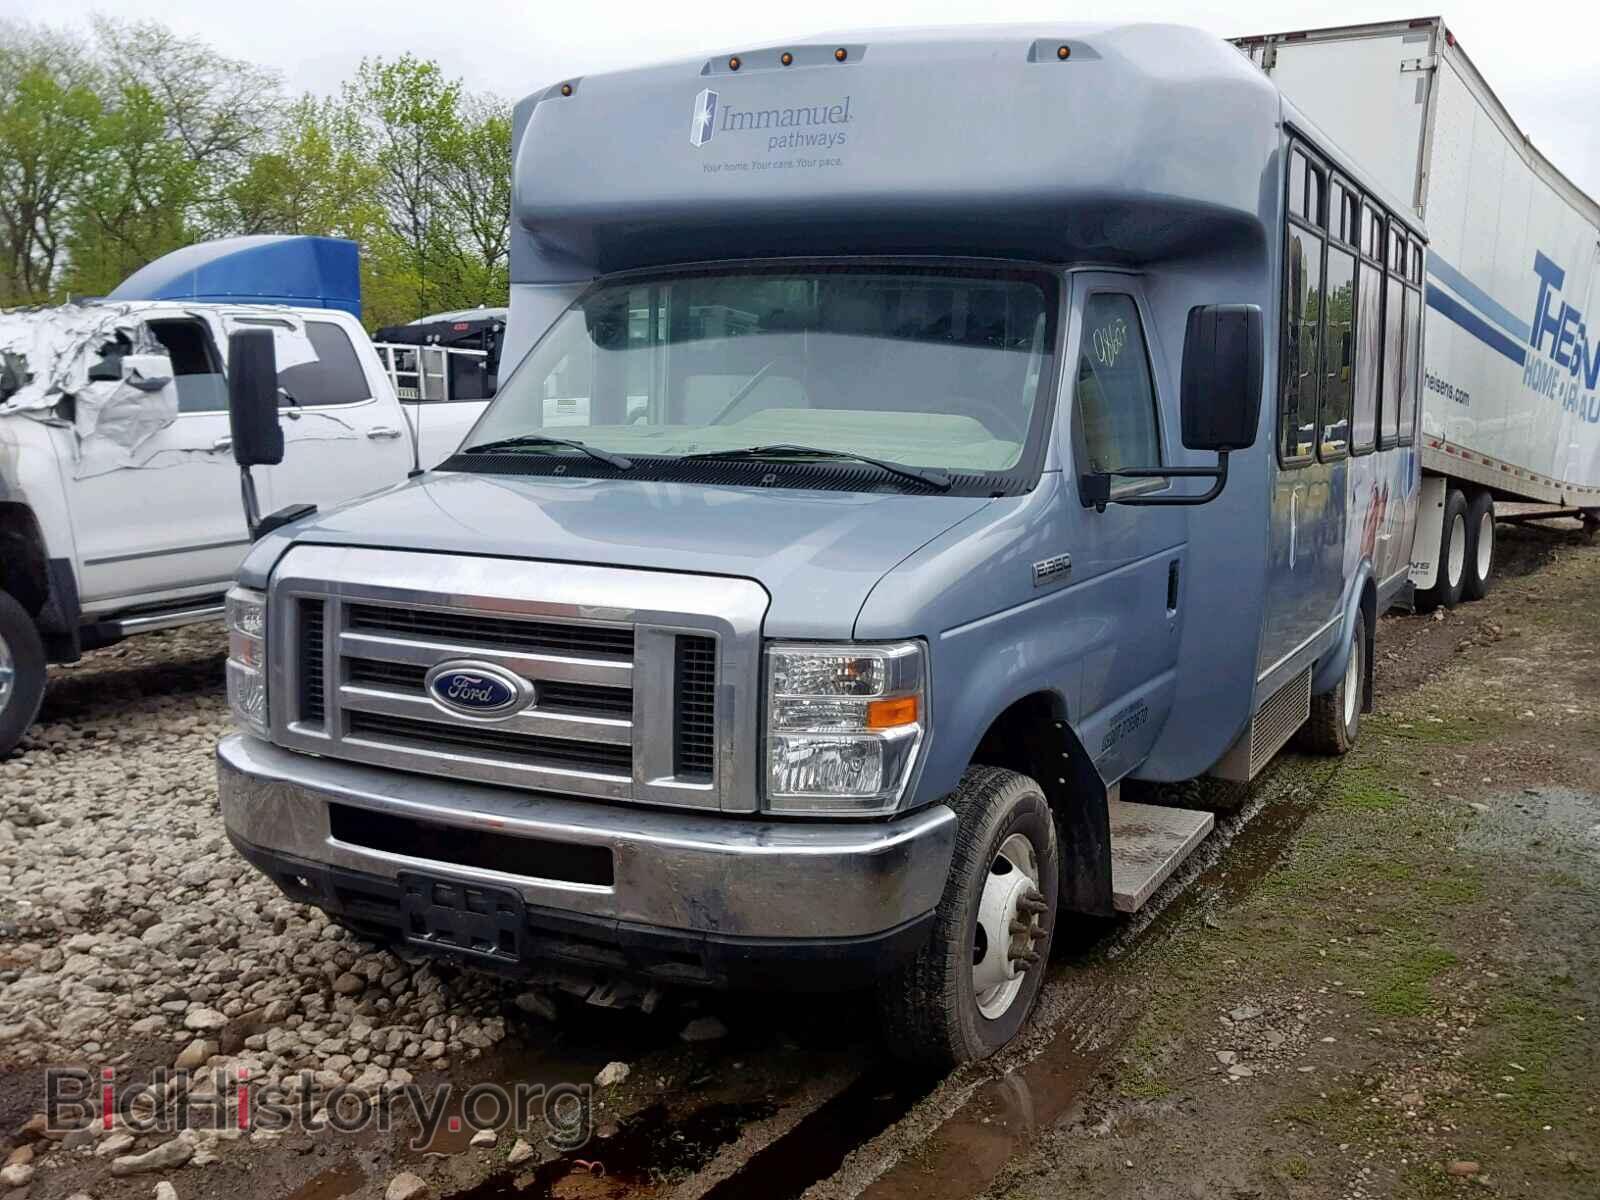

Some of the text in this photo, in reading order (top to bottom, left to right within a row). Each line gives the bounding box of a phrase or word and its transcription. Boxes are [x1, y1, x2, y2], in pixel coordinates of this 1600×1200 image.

[720, 96, 850, 131] Immanuel
[768, 131, 846, 152] pathways
[448, 675, 493, 701] Ford
